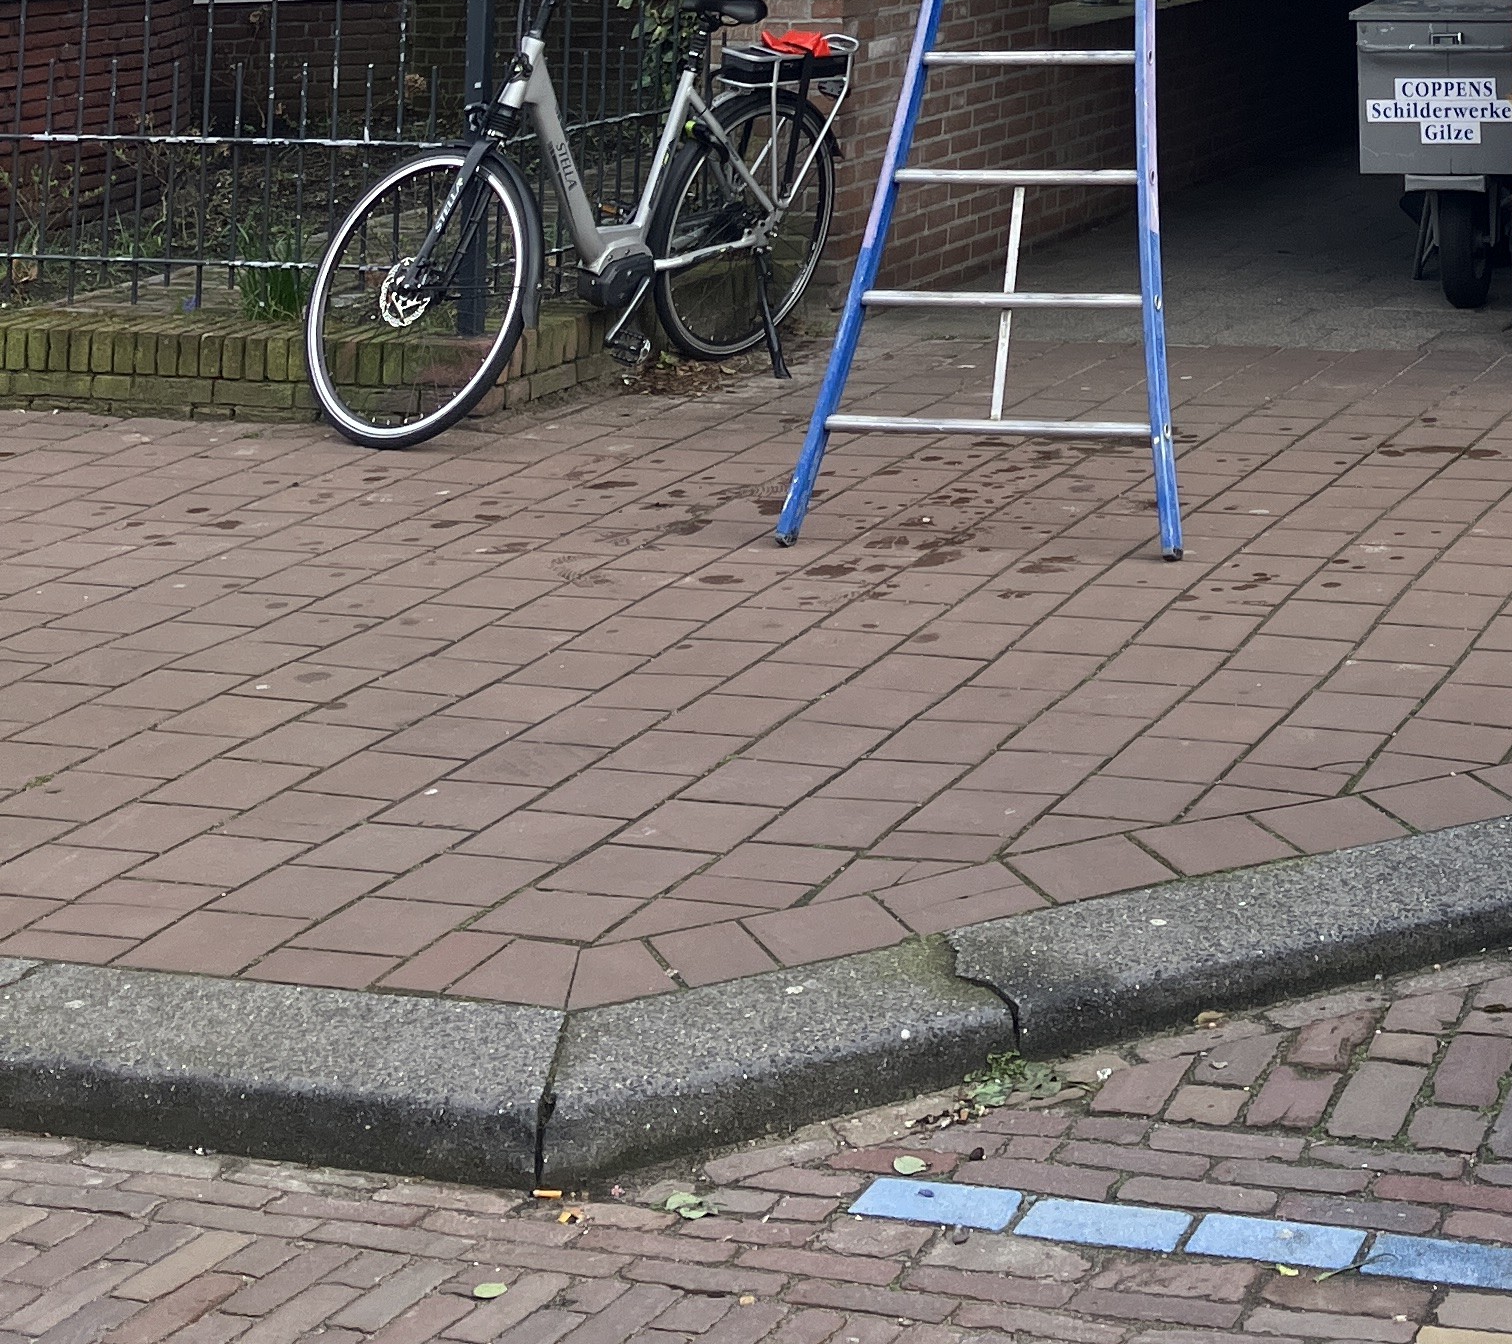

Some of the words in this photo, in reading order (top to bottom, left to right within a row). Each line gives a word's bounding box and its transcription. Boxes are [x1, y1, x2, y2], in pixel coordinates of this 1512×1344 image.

[1401, 80, 1493, 98] COPPENS
[1424, 124, 1474, 141] Gilze
[556, 142, 577, 192] STELLA
[435, 177, 464, 233] STELLA
